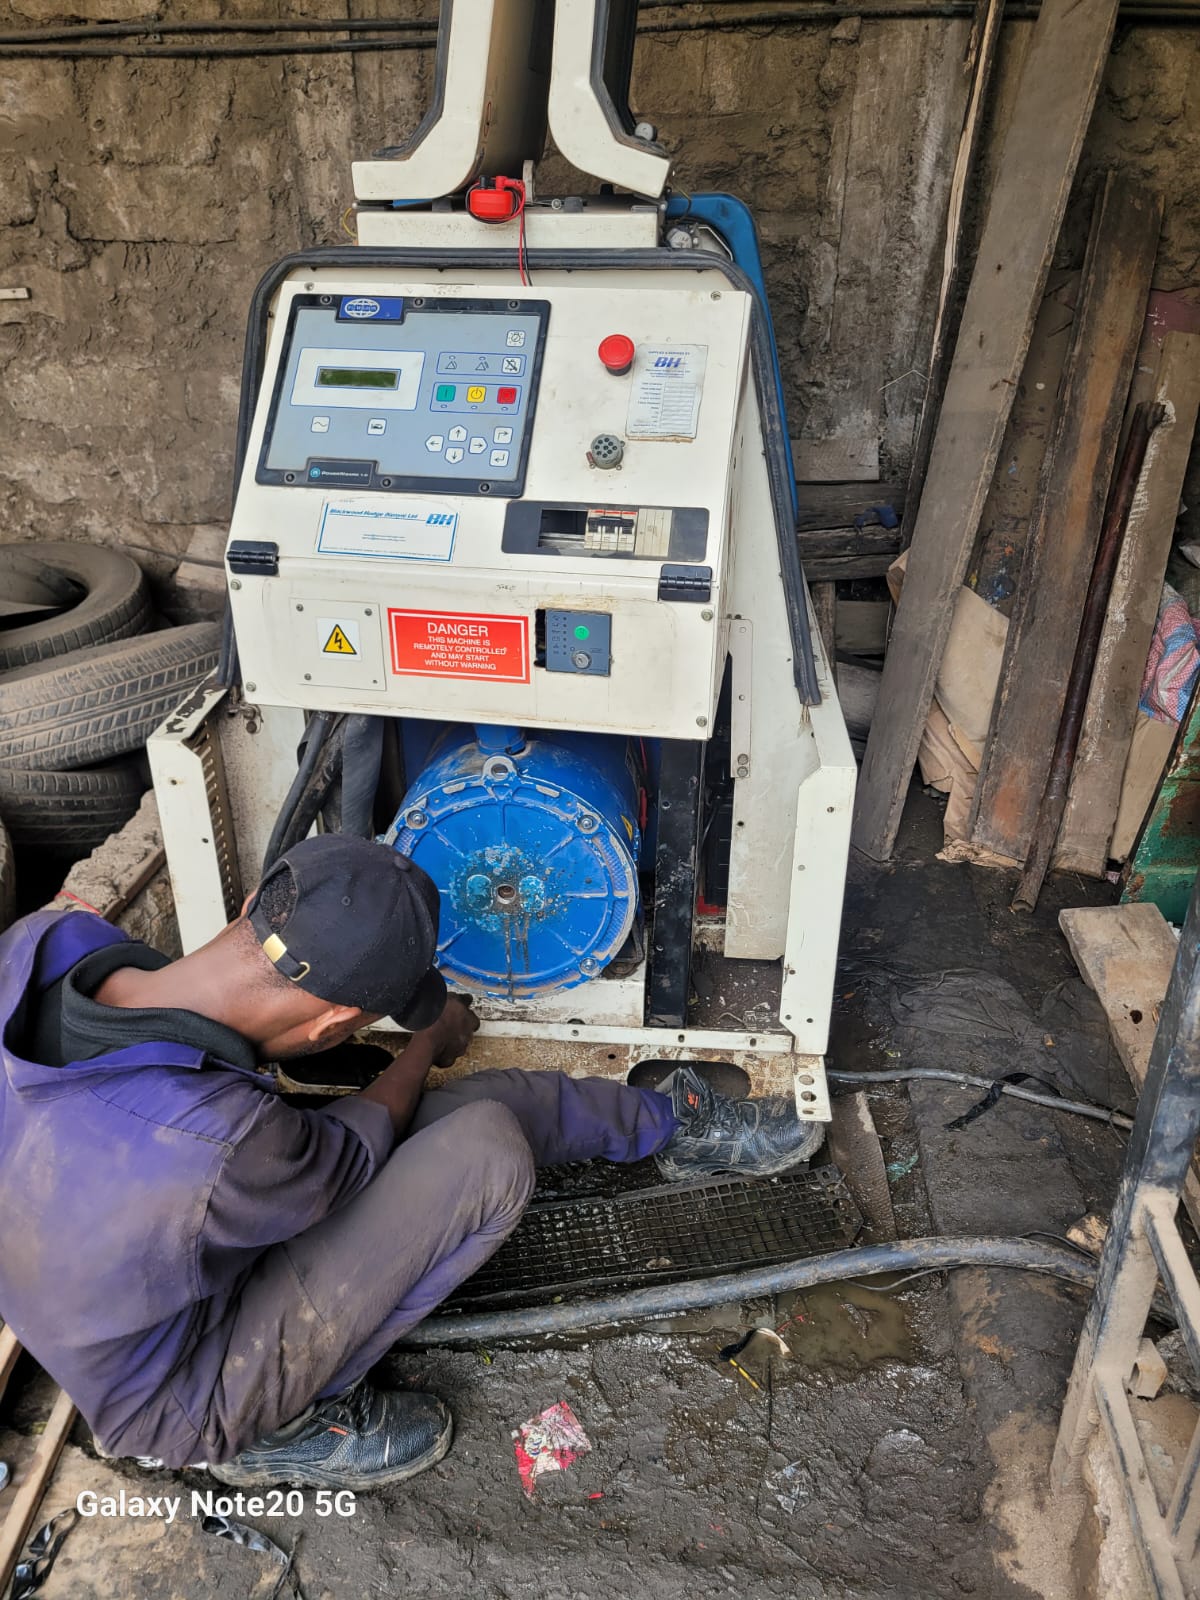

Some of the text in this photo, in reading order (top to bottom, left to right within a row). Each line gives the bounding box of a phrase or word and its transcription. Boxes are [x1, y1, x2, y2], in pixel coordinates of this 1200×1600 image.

[654, 357, 682, 368] BH
[426, 513, 455, 525] BH
[427, 622, 489, 637] DANGER
[428, 636, 446, 644] THIS
[446, 637, 481, 646] MACHINE
[413, 642, 507, 655] REMOTELY CONTROLLED
[448, 653, 463, 661] MAY
[465, 654, 489, 662] START
[424, 659, 496, 671] WITHOUT WARNING
